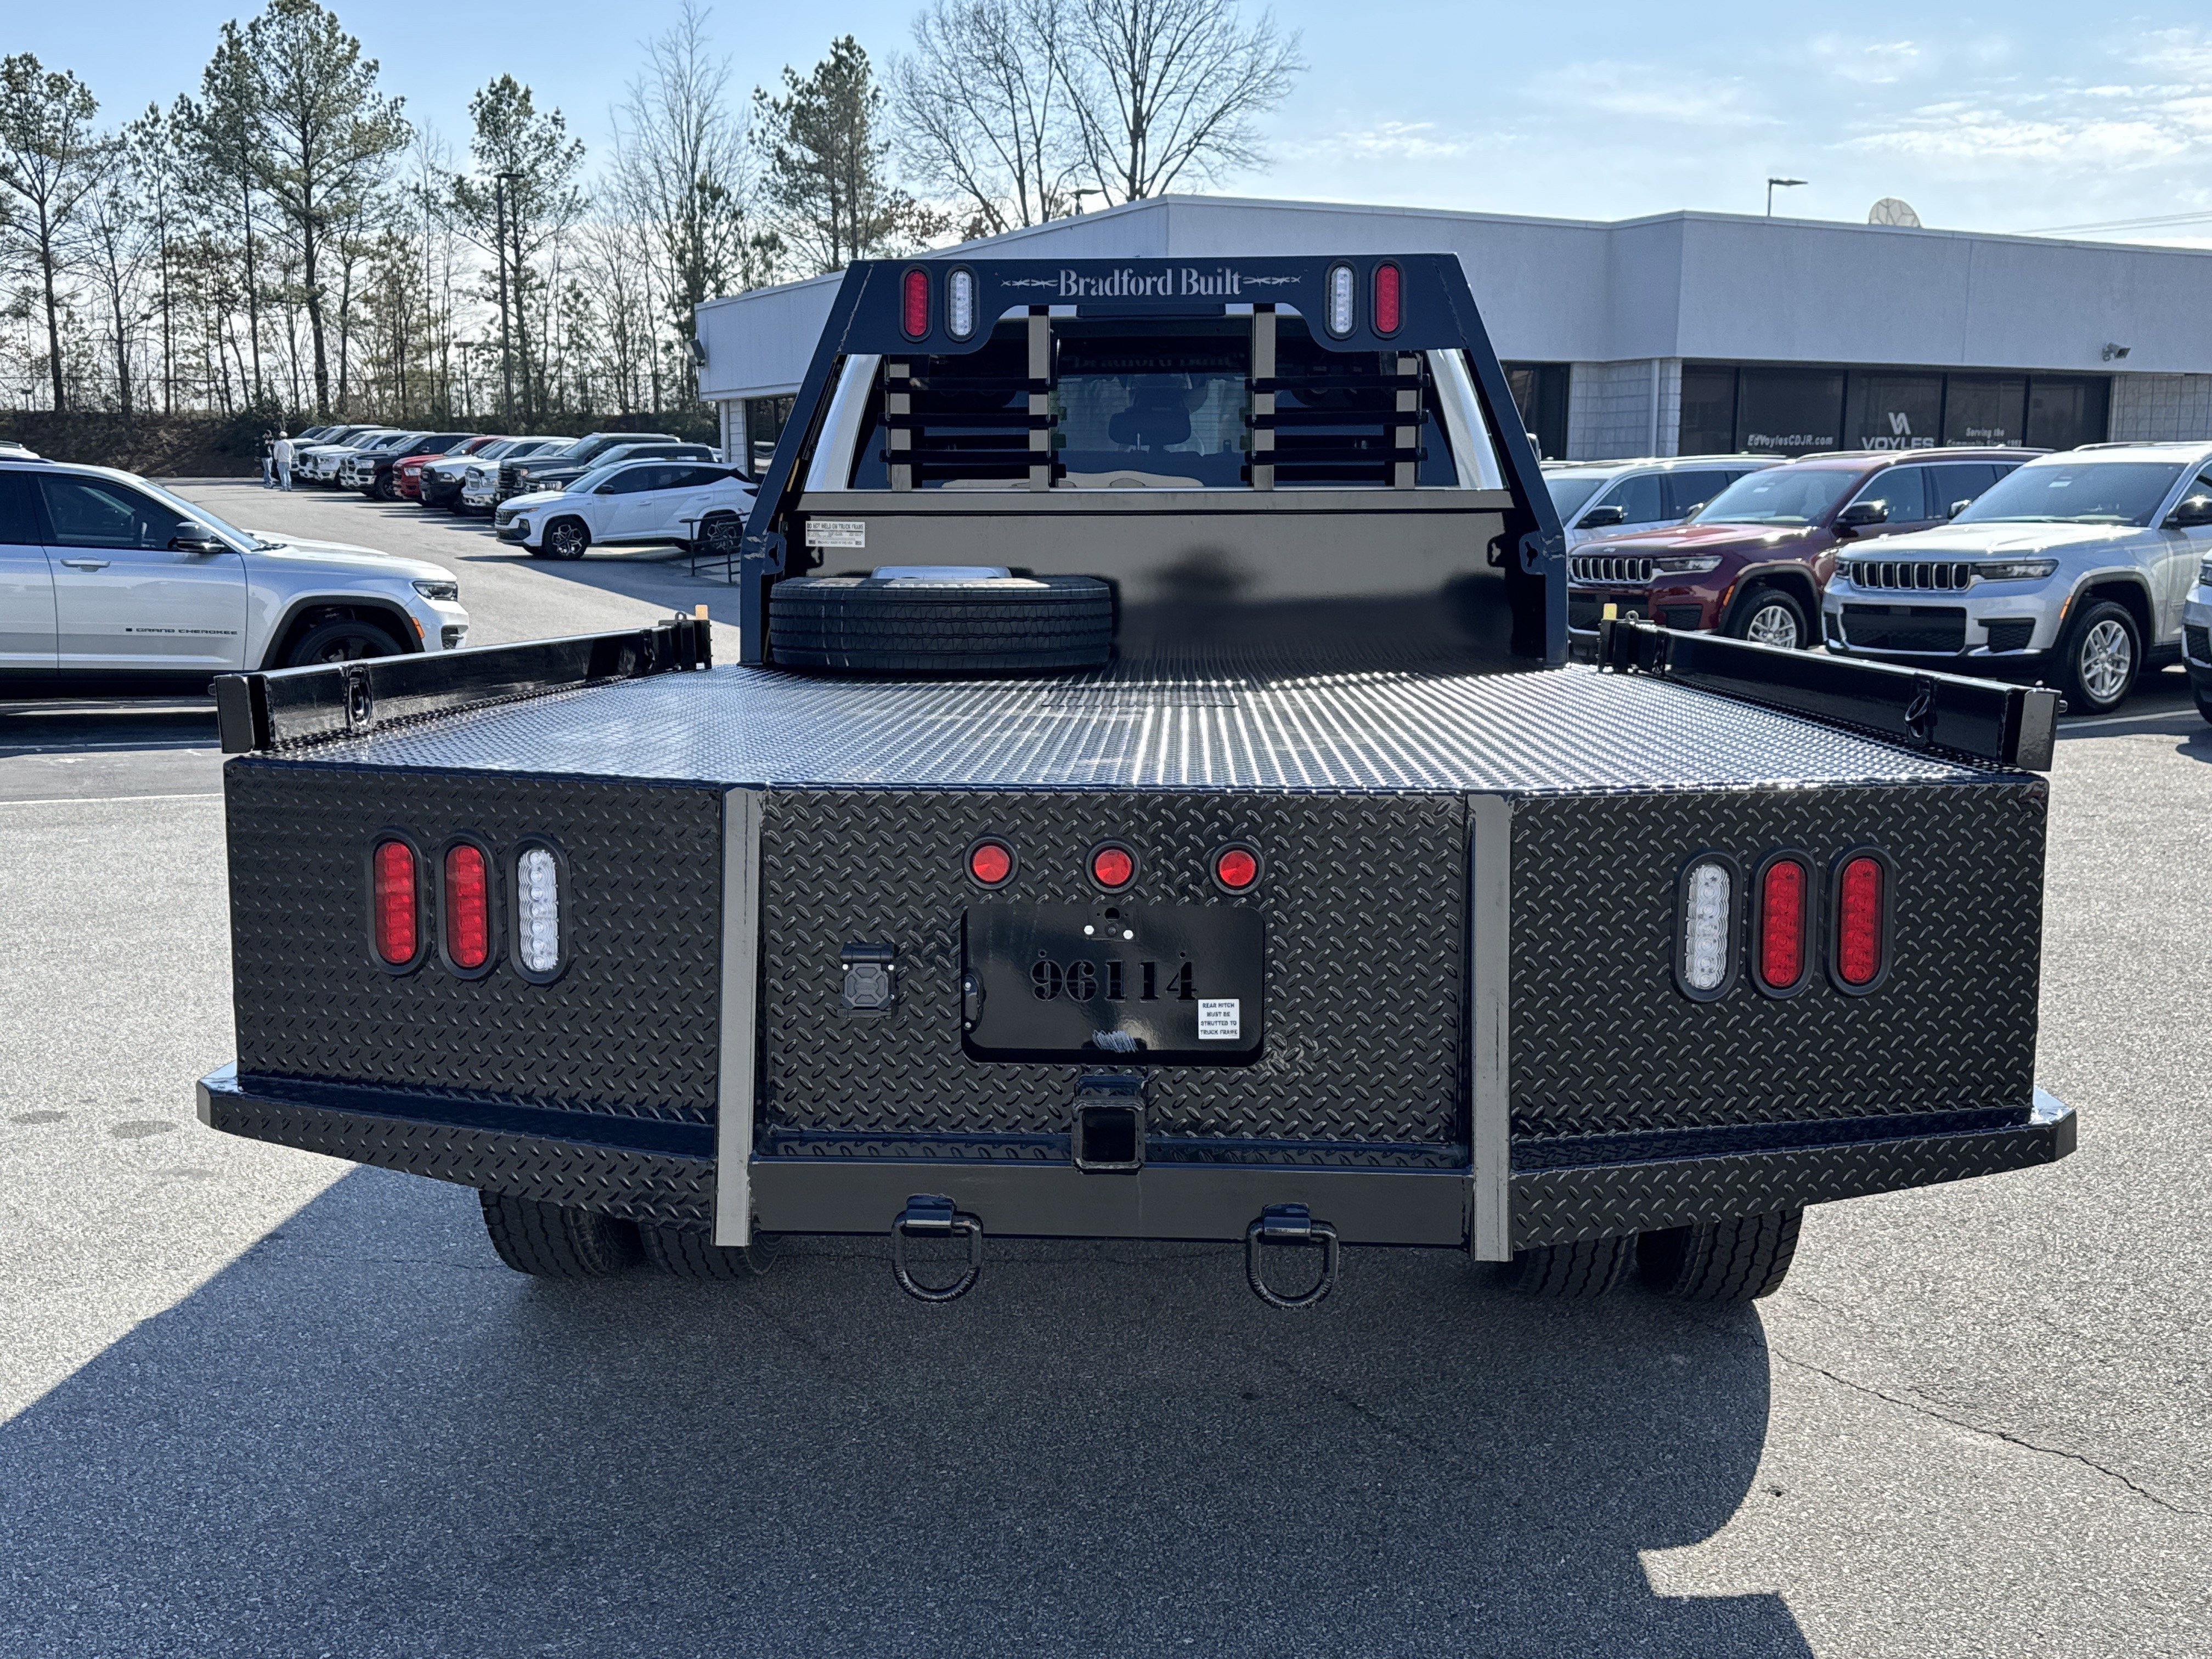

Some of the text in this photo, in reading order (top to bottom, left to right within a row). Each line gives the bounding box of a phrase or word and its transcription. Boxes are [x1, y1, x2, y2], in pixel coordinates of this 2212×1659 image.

[1058, 268, 1242, 296] Bradford Built
[1966, 427, 2005, 438] Serving the
[1747, 433, 1833, 448] EdVoylesCDJR.com
[1861, 437, 1934, 450] VOYLES
[1030, 960, 1198, 1002] 96114
